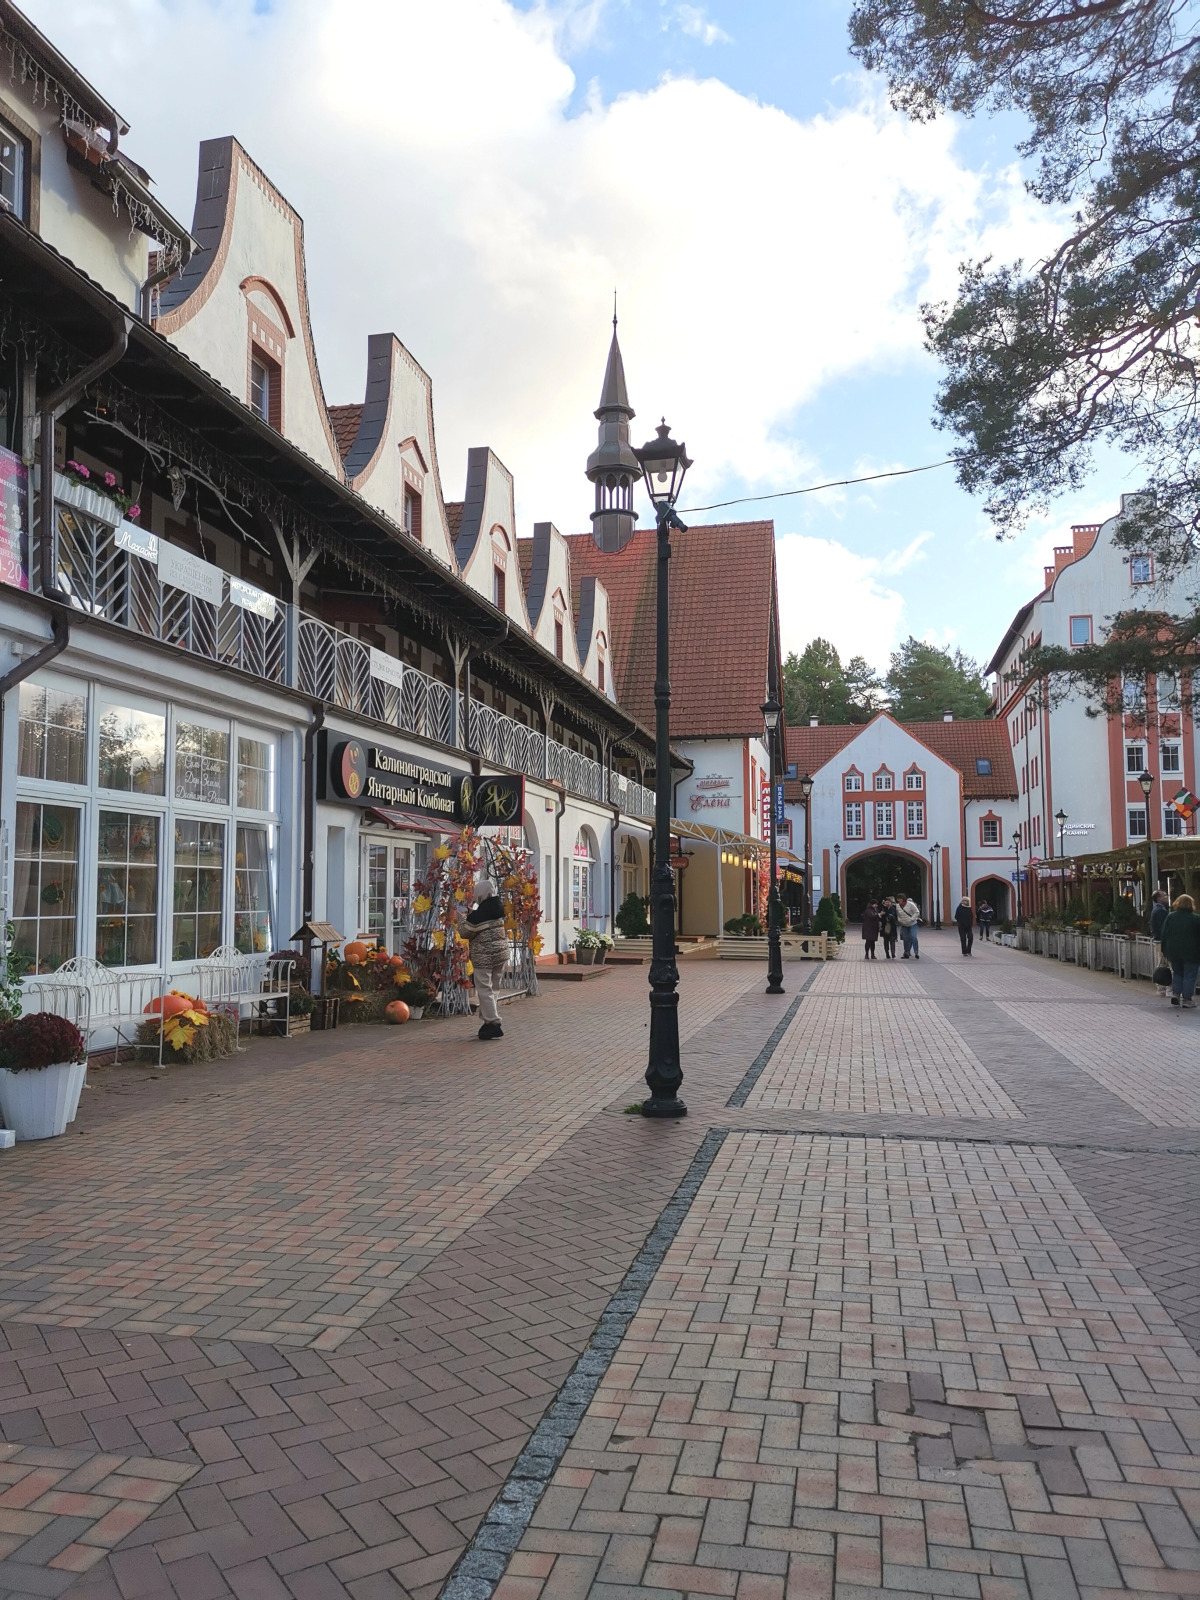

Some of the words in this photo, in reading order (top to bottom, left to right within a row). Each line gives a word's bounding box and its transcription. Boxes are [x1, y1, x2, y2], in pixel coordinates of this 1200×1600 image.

[169, 569, 178, 579] ИЗ
[178, 573, 213, 595] САМОЦВЕТОВ
[170, 558, 213, 586] УКРАШЕНИЯ
[374, 748, 452, 788] Калининградский
[367, 777, 416, 805] Янтарный
[416, 788, 456, 814] Комбинат
[689, 794, 731, 812] Елена
